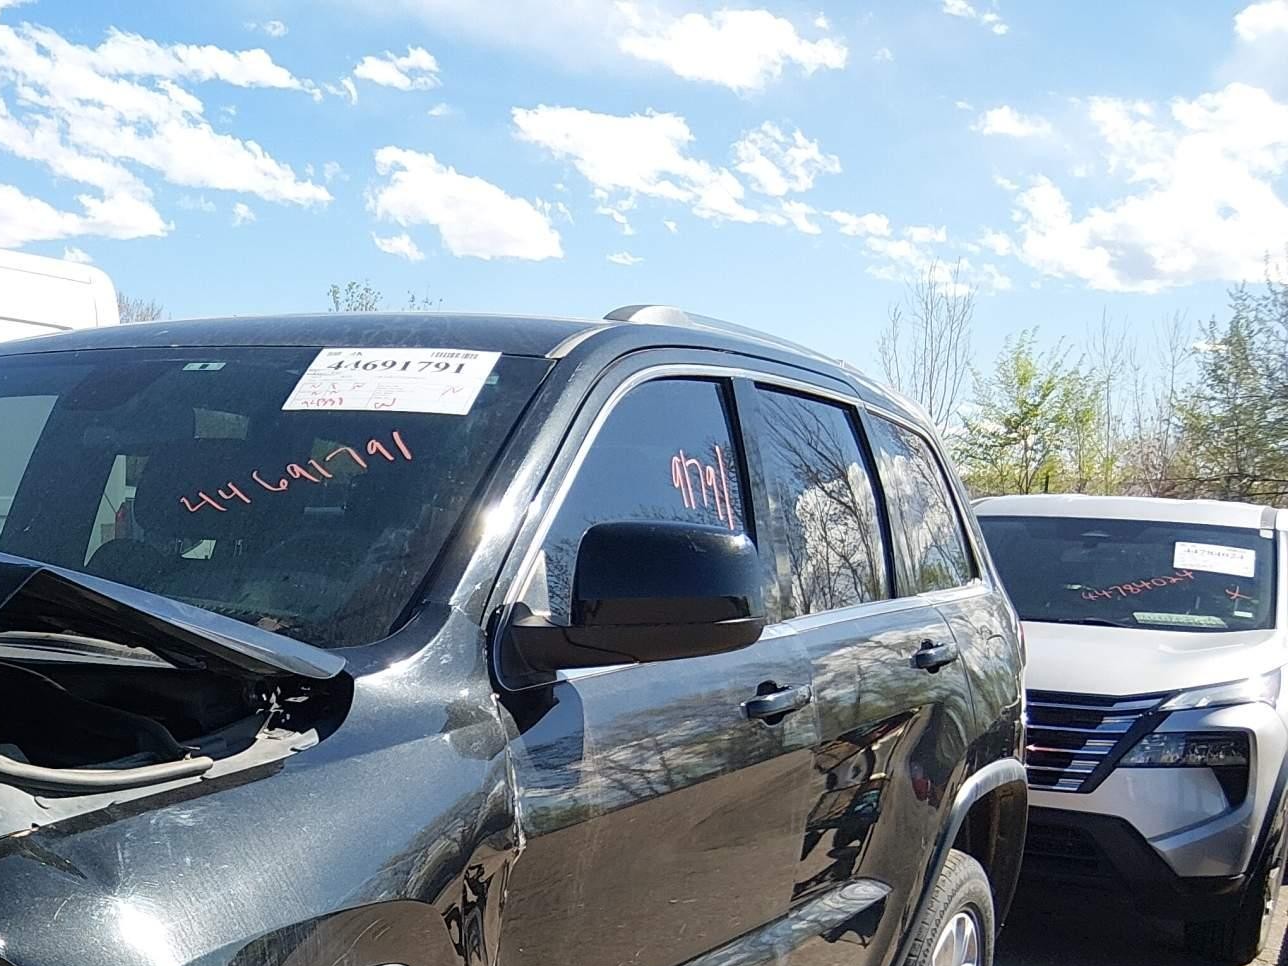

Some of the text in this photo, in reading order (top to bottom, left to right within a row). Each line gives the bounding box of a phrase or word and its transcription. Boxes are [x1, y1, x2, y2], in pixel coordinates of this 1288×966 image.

[326, 359, 465, 374] 44691791
[180, 431, 412, 512] 44691791
[1081, 569, 1194, 601] 44784024
